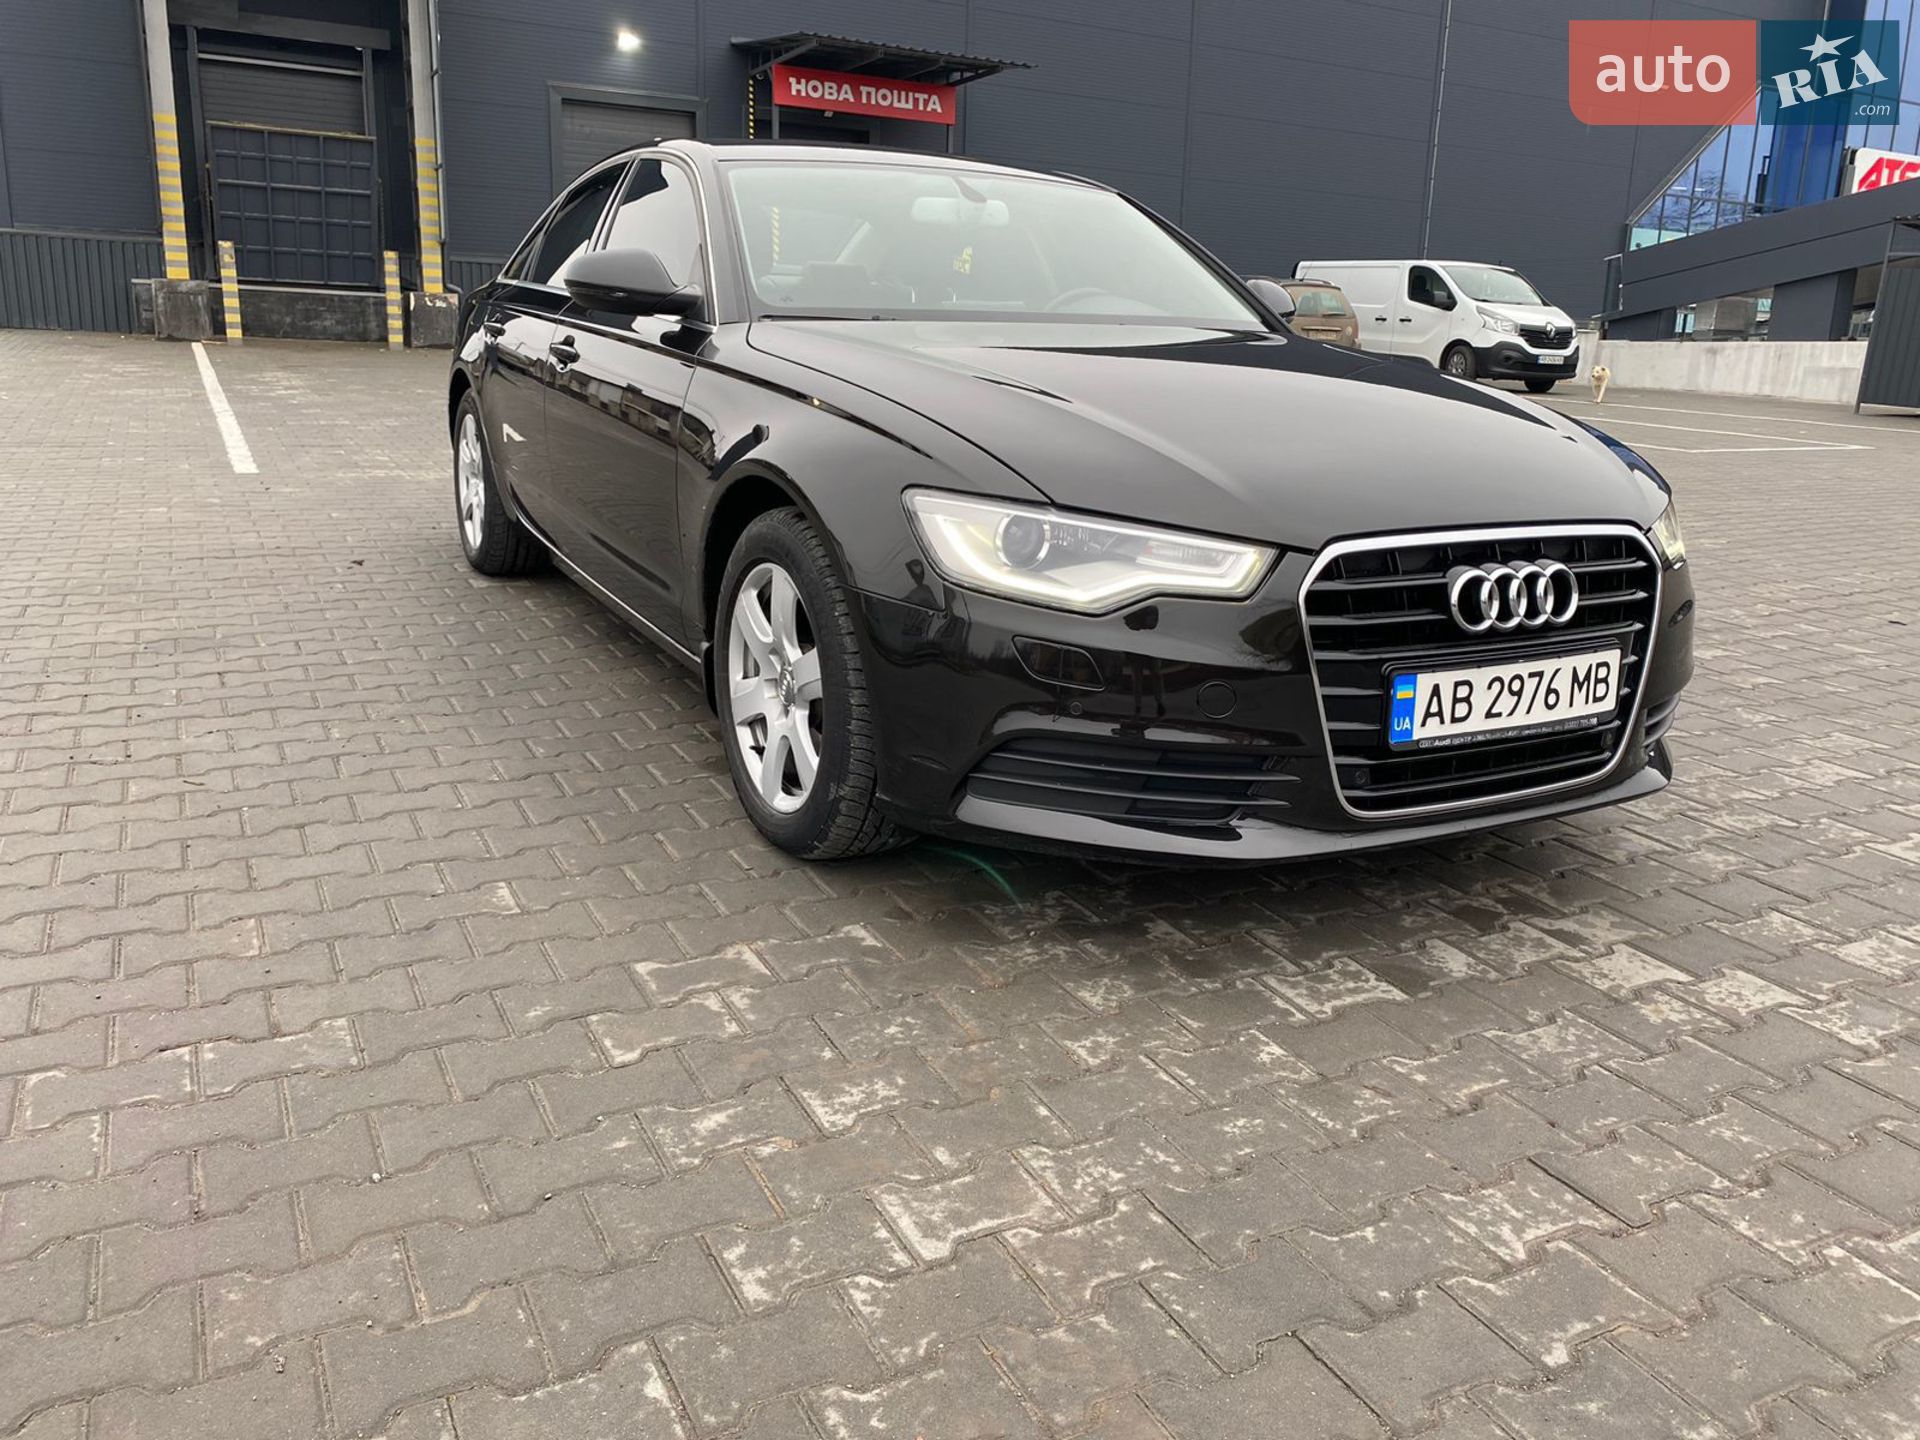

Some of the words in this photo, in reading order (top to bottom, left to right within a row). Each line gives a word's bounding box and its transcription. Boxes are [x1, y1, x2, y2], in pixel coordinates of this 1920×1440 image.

[789, 77, 854, 103] НОВА
[860, 86, 942, 113] ПОШТА
[1420, 680, 1473, 728] AB
[1484, 667, 1562, 719] 2976
[1569, 660, 1611, 708] MB
[1394, 716, 1411, 731] UA
